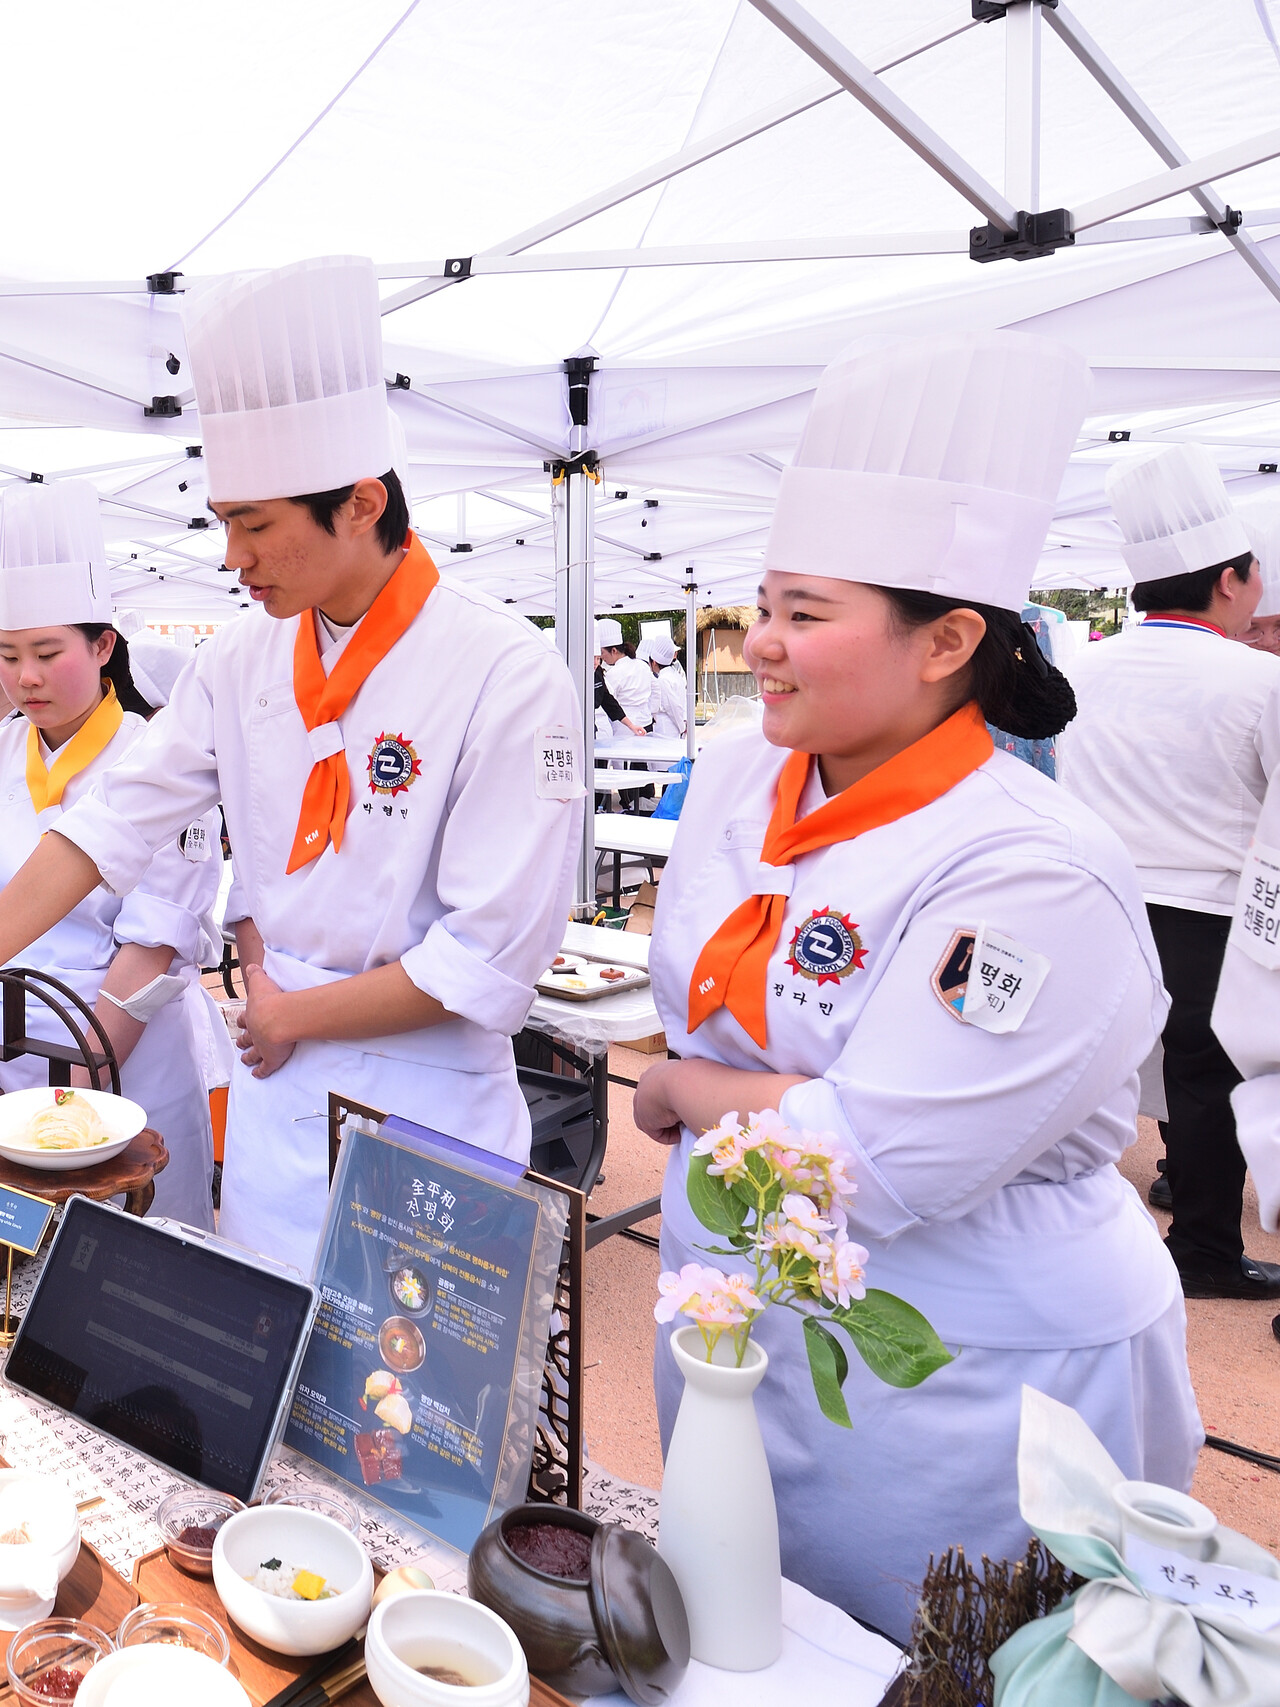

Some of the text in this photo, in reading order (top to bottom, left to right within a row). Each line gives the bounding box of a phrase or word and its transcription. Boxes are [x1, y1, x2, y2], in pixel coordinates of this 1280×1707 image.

[543, 749, 573, 768] 전평화
[304, 829, 320, 845] KM
[824, 917, 853, 965] FOODSERVICE
[807, 962, 842, 973] SCHOOL
[698, 976, 716, 995] KM
[411, 1178, 457, 1210] 全平和
[406, 1198, 455, 1234] 전평화
[298, 1382, 327, 1404] 유자 모약과
[420, 1393, 450, 1416] 평양 백김치
[1157, 1564, 1260, 1609] 전주 모주
